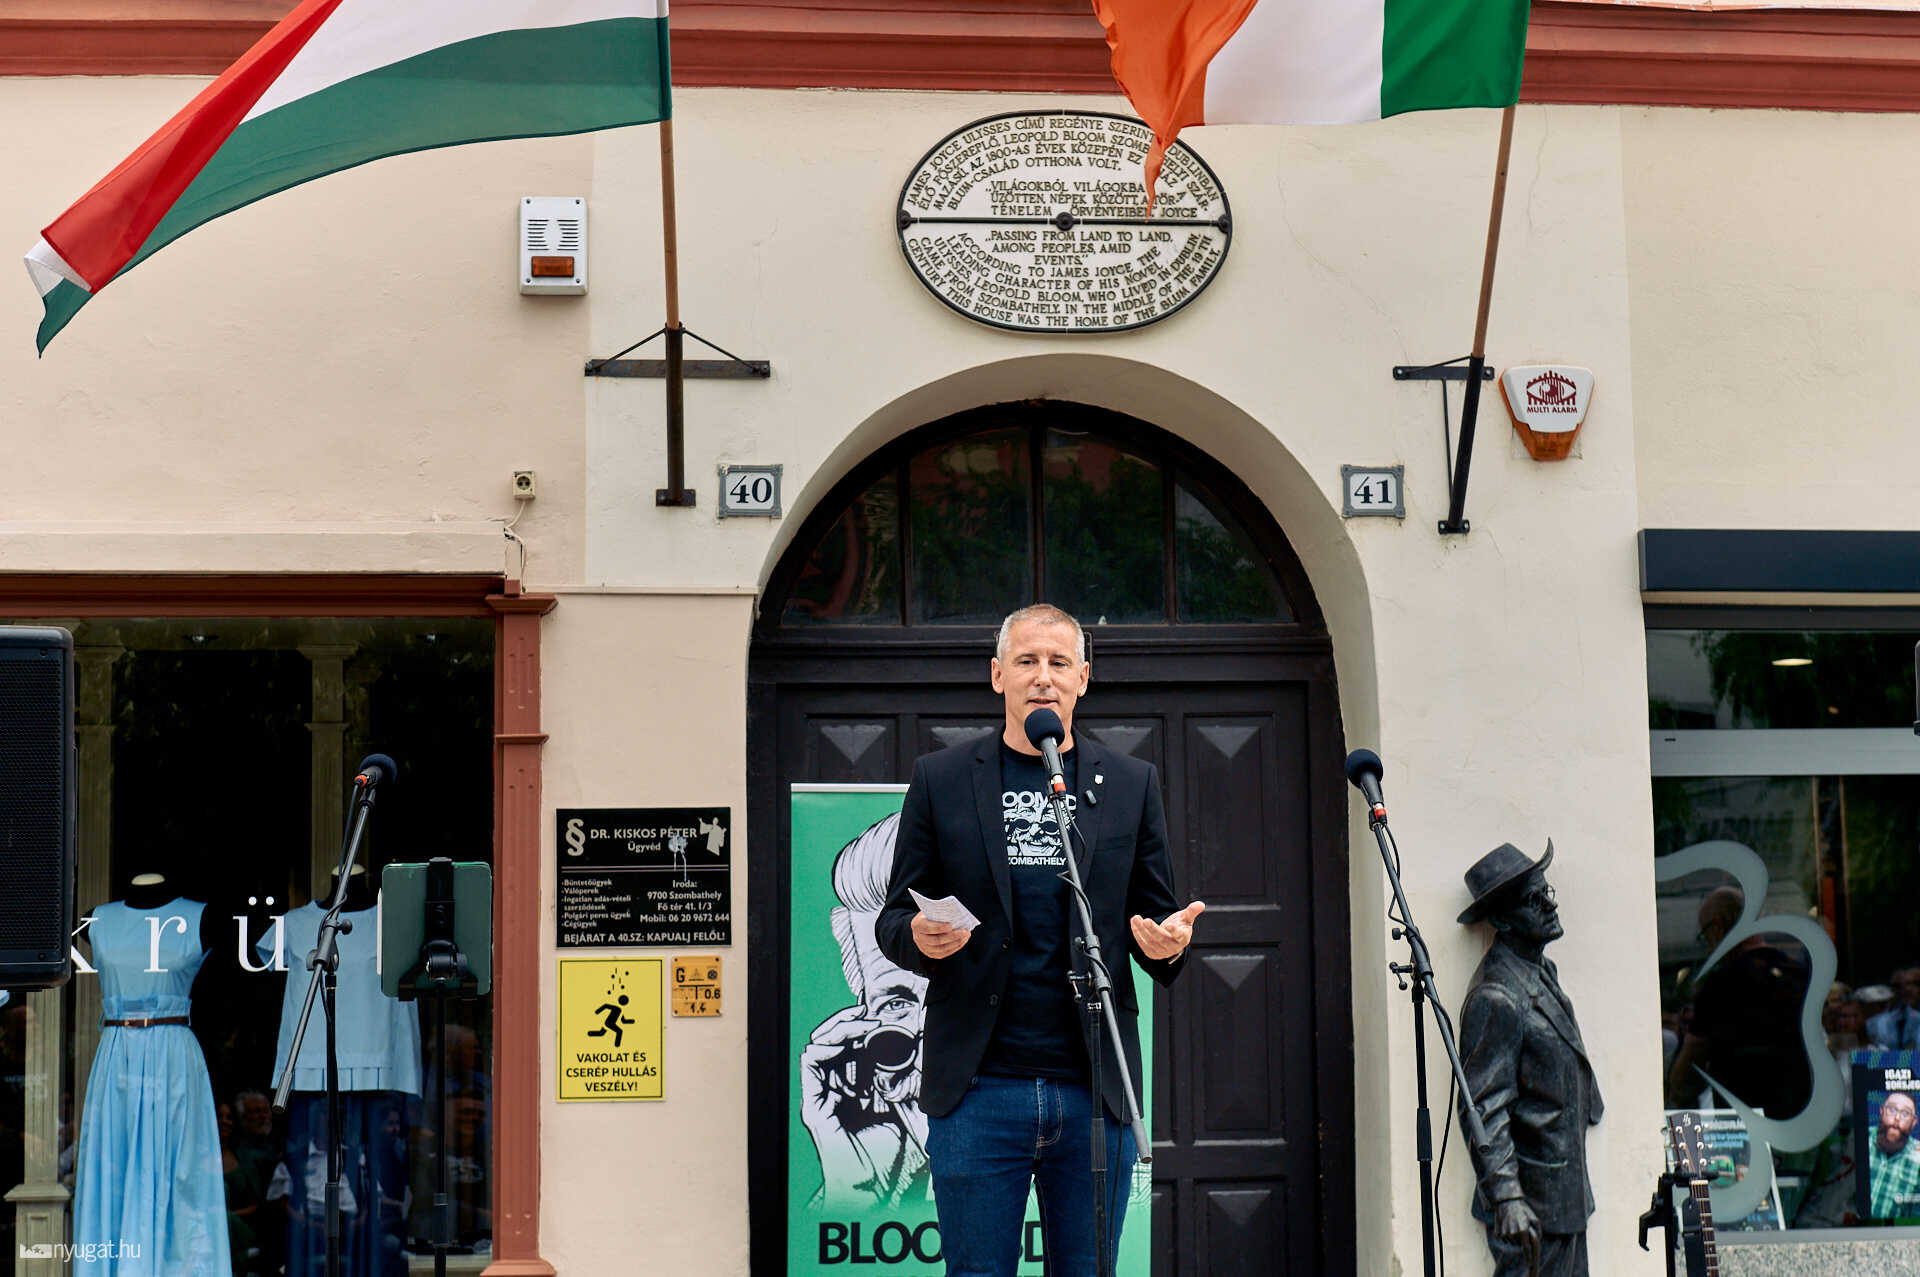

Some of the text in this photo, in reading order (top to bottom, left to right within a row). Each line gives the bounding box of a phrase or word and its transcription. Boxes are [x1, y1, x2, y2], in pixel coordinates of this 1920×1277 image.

[1003, 131, 1059, 145] LEOPOLD
[1063, 131, 1106, 143] BLOOM
[907, 170, 931, 206] JAMES
[930, 140, 962, 170] JOYCE
[962, 121, 1011, 144] ULYSSES
[1050, 117, 1103, 130] REGÉNYE
[970, 156, 984, 171] AZ
[985, 144, 1030, 162] 1800-AS
[1035, 142, 1066, 154] ÉVEK
[1071, 142, 1124, 159] KÖZEPÉN
[1127, 152, 1143, 165] EZ
[1176, 190, 1187, 200] A
[947, 156, 1122, 211] BLUM-CSALÁD OTTHONA VOLT.
[1050, 192, 1087, 204] NÉPEK
[990, 203, 1053, 216] TÉNELEM
[1160, 207, 1198, 218] JOYCE
[1042, 231, 1075, 242] FROM
[1080, 231, 1113, 242] LAND
[1117, 231, 1133, 242] TO
[958, 232, 1161, 278] ACCORDING TO JAMES JOYCE THE
[992, 243, 1036, 253] AMONG
[1099, 243, 1132, 254] AMID
[946, 235, 1163, 290] LEADING CHARACTER OF HIS NOVEL
[908, 238, 947, 288] CENTURY
[946, 286, 972, 309] THIS
[973, 303, 1013, 322] HOUSE
[1017, 315, 1040, 325] WAS
[1046, 316, 1069, 327] THE
[1074, 316, 1109, 327] HOME
[1112, 314, 1129, 325] OF
[1134, 306, 1158, 321] THE
[1159, 287, 1190, 311] BLUM
[920, 237, 946, 270] CAME
[943, 270, 975, 297] FROM
[1065, 303, 1078, 314] IN
[1083, 303, 1107, 314] THE
[1113, 293, 1156, 313] MIDDLE
[1158, 282, 1173, 297] OF
[1174, 263, 1195, 285] THE
[1191, 252, 1204, 264] 19
[974, 277, 1031, 301] LEOPOLD
[1038, 291, 1084, 303] BLOOM,
[1087, 290, 1116, 302] WHO
[1121, 279, 1157, 300] LIVED
[1157, 269, 1171, 282] IN
[730, 475, 772, 504] 40
[1354, 476, 1393, 504] 41
[590, 825, 698, 839] DR. KISKOS PÉTER
[627, 841, 661, 853] Ügyvéd
[1008, 857, 1067, 866] OMBATHELY
[672, 879, 698, 888] Iroda:
[647, 890, 722, 901] 9700 Szombathely
[669, 903, 683, 911] tér
[640, 913, 730, 922] Mobil: 06 20 9672 644
[564, 932, 607, 945] BEJÁRAT
[608, 933, 616, 942] A
[647, 932, 691, 943] KAPUALJ
[676, 968, 685, 983] G
[576, 1051, 647, 1063] VAKOLAT ÉS
[566, 1065, 657, 1078] CSERÉP HULLÁS
[585, 1080, 638, 1092] VESZÉLY!
